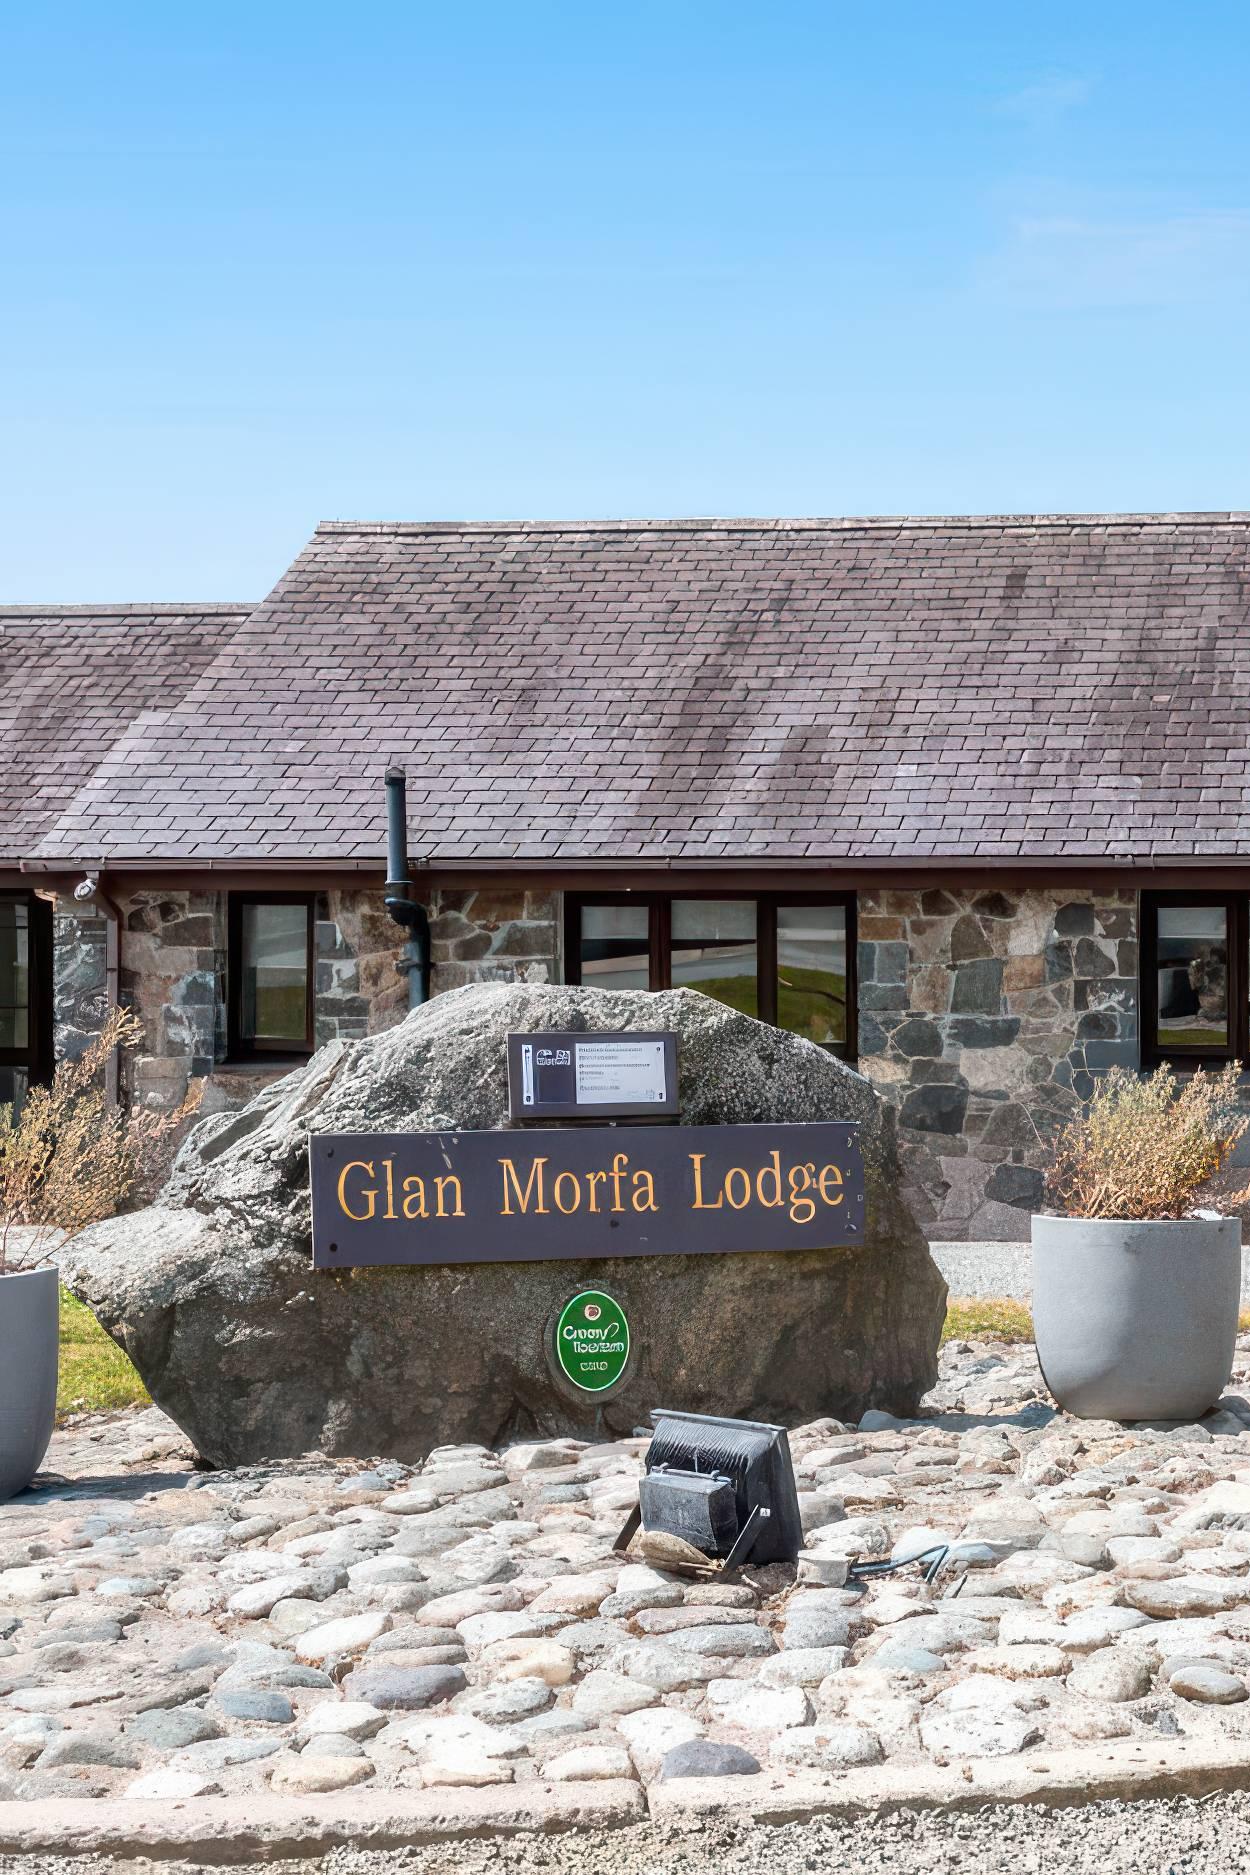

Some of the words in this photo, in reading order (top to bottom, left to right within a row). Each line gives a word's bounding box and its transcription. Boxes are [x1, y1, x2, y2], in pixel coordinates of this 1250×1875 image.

[336, 1159, 466, 1220] Glan
[498, 1153, 659, 1216] Morfa
[688, 1151, 845, 1223] Lodge
